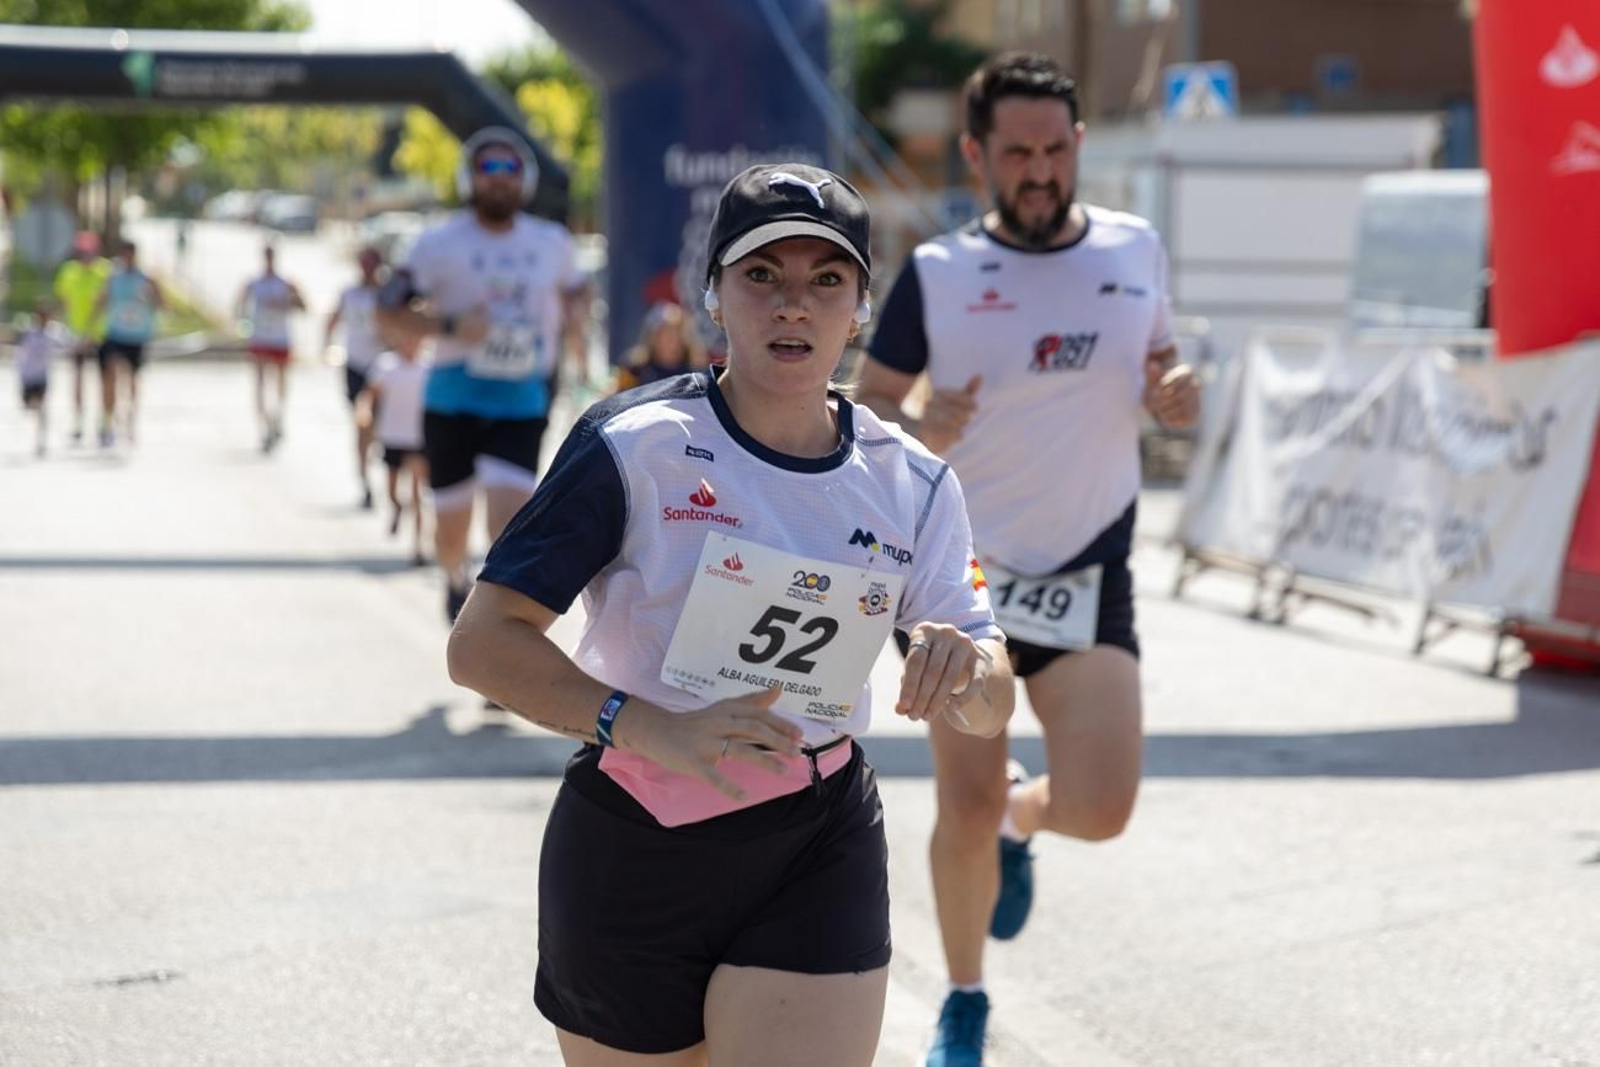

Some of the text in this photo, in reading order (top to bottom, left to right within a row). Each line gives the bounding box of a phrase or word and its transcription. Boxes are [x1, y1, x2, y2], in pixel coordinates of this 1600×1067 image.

[663, 506, 738, 527] Santander
[704, 564, 754, 587] Santander
[791, 570, 831, 592] 200
[997, 578, 1072, 621] 149
[738, 604, 839, 674] 52
[717, 667, 742, 682] ALBA
[784, 680, 822, 698] DELGADO
[806, 708, 847, 718] NACIONAL
